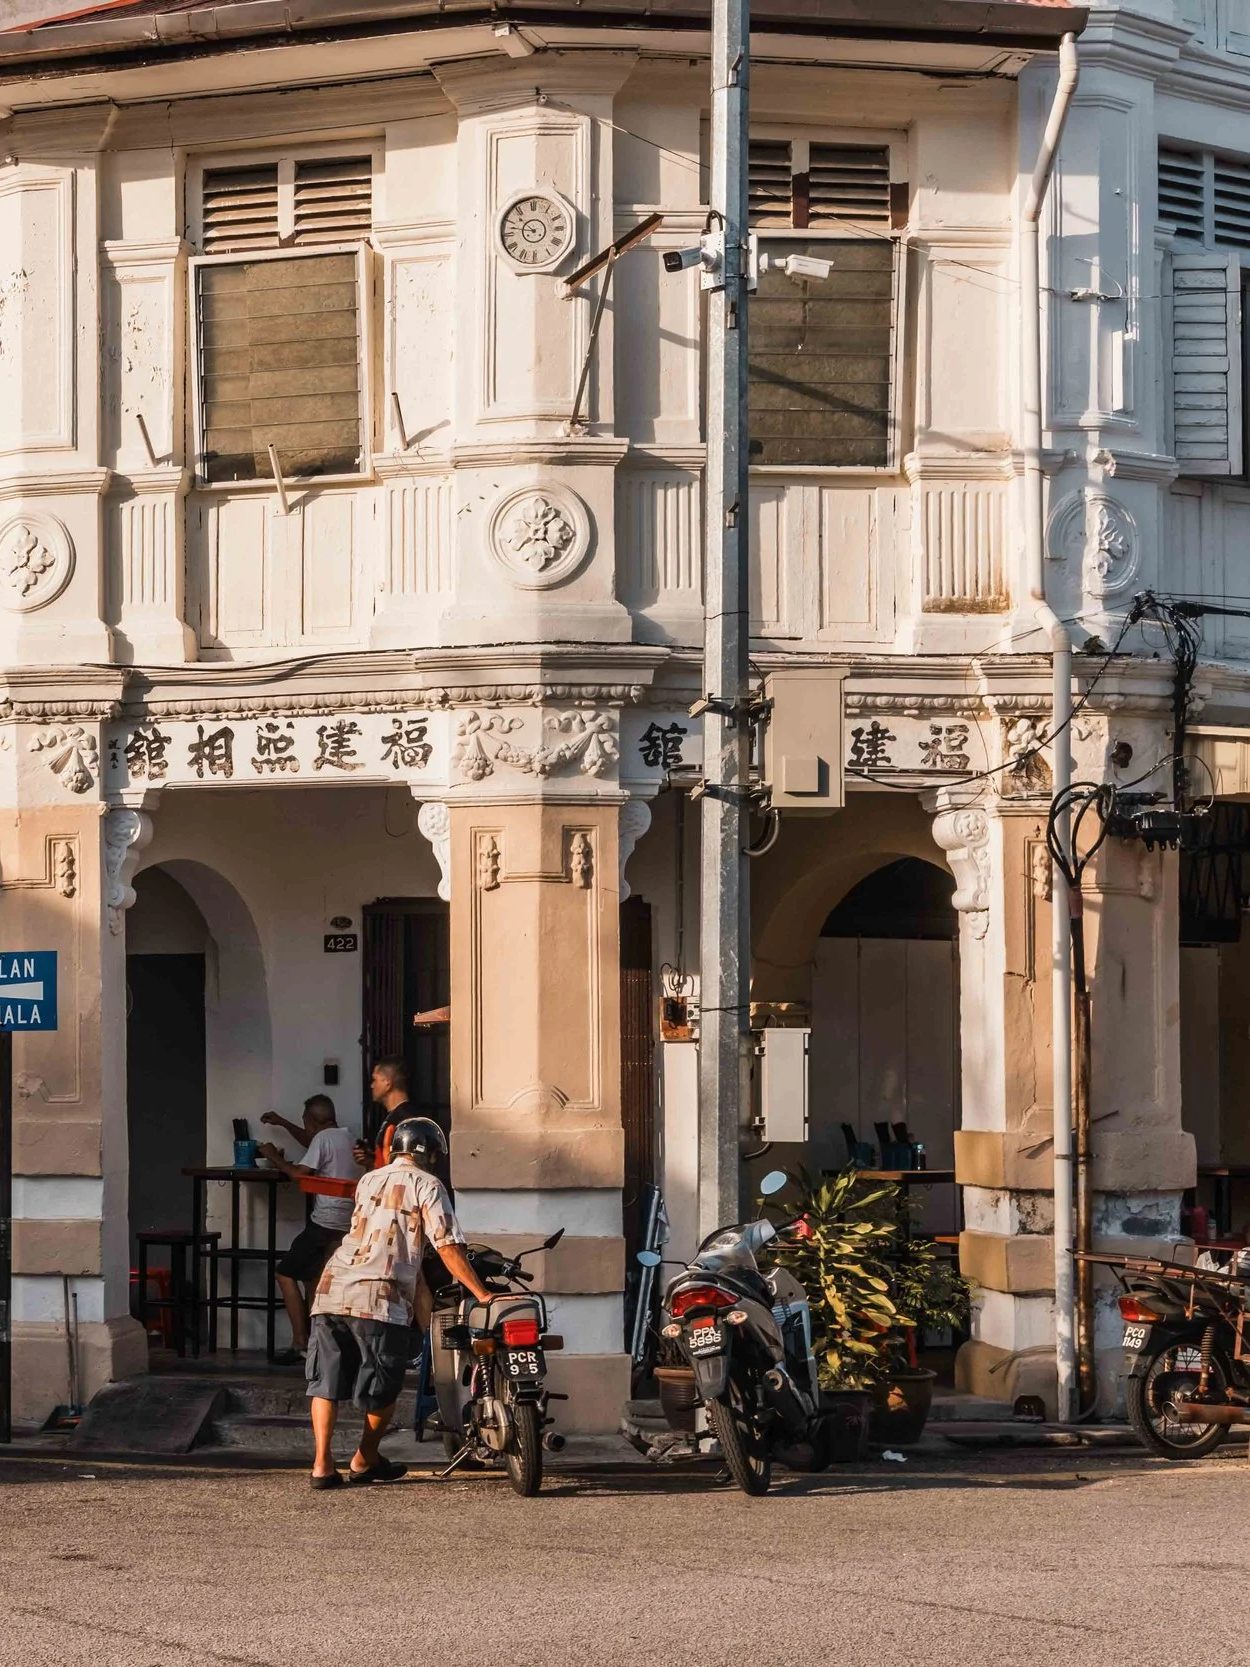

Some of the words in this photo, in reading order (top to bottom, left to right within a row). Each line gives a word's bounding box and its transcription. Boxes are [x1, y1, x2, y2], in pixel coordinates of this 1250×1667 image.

[327, 937, 355, 949] 422
[693, 1326, 716, 1340] PPA
[689, 1333, 722, 1348] 5896
[1122, 1336, 1142, 1349] 1149
[508, 1351, 537, 1364] PCR
[510, 1363, 538, 1375] 95
